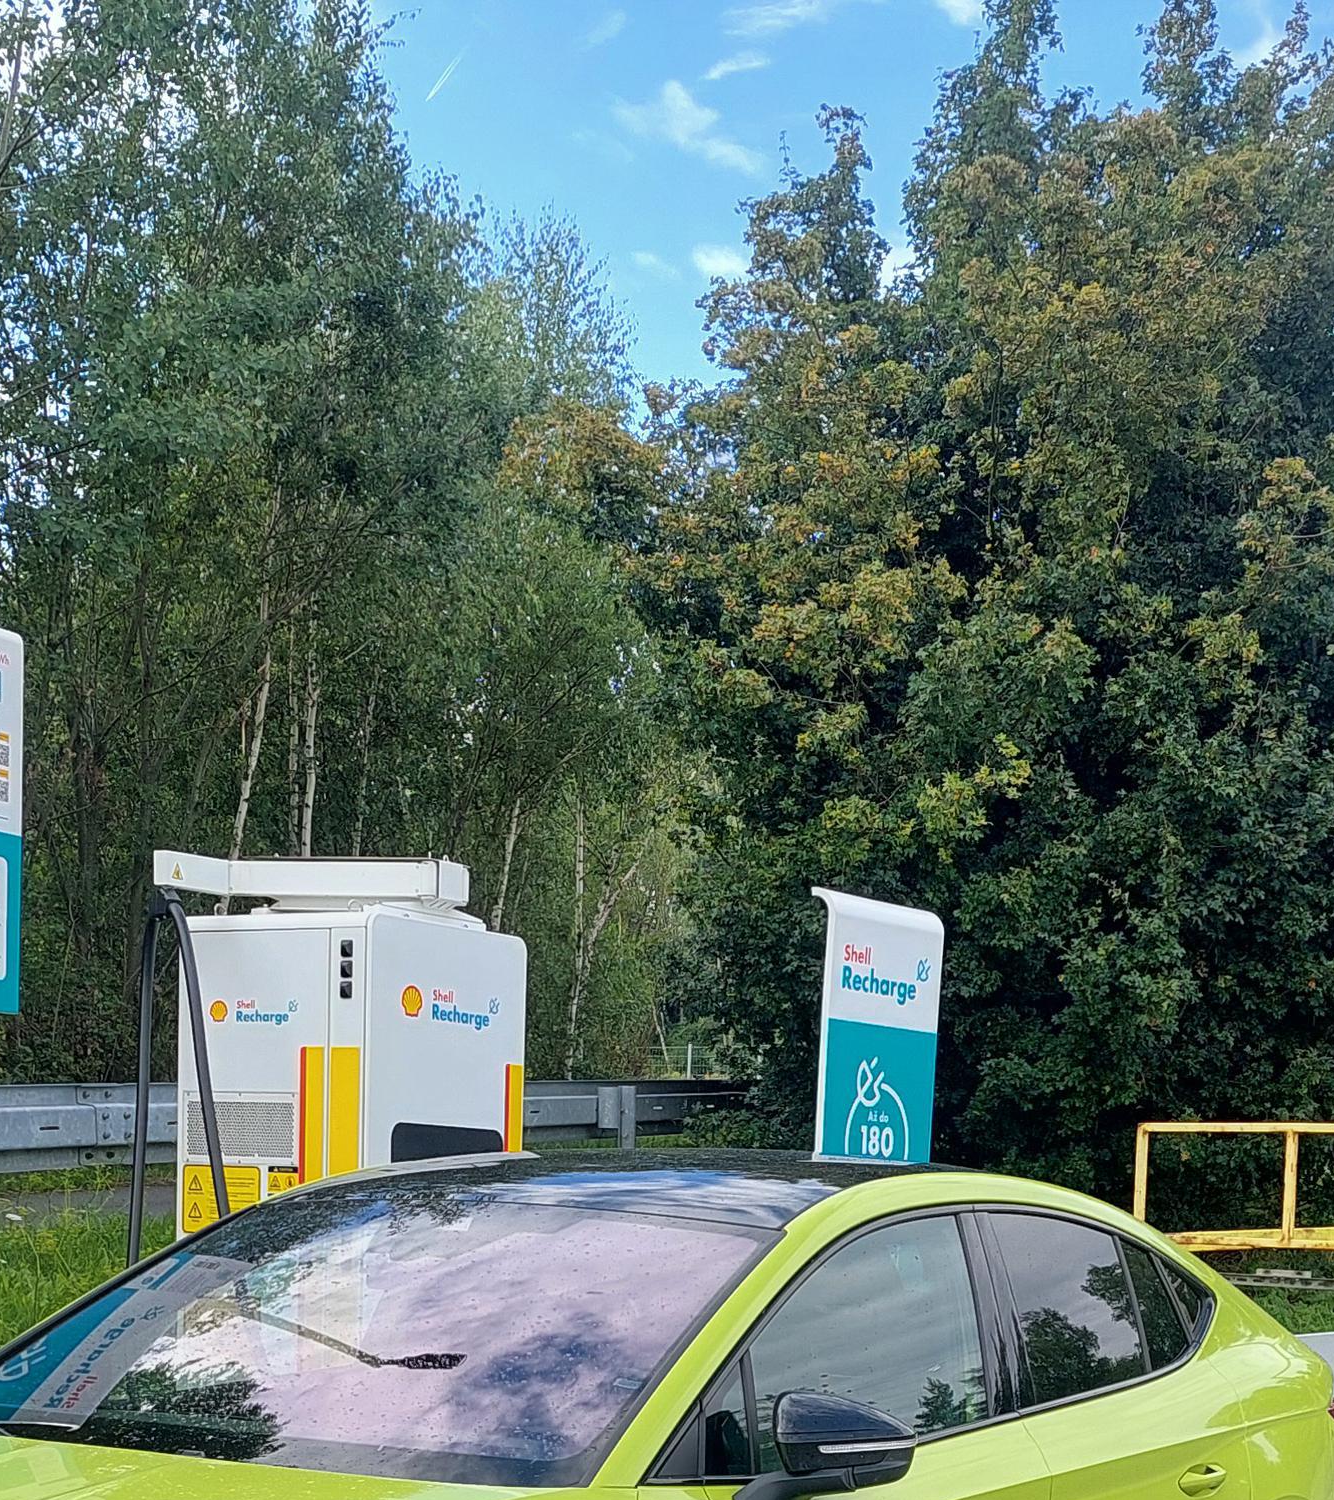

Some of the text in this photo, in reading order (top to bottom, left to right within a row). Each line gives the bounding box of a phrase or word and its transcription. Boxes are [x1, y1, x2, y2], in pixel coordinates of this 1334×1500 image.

[844, 944, 872, 965] Shell
[842, 965, 917, 1005] Recharge
[236, 999, 255, 1009] Shell
[433, 989, 454, 1004] Shell
[236, 1009, 289, 1025] Recharge
[432, 1003, 490, 1031] Recharge
[867, 1110, 889, 1123] Až do
[861, 1124, 894, 1158] 180
